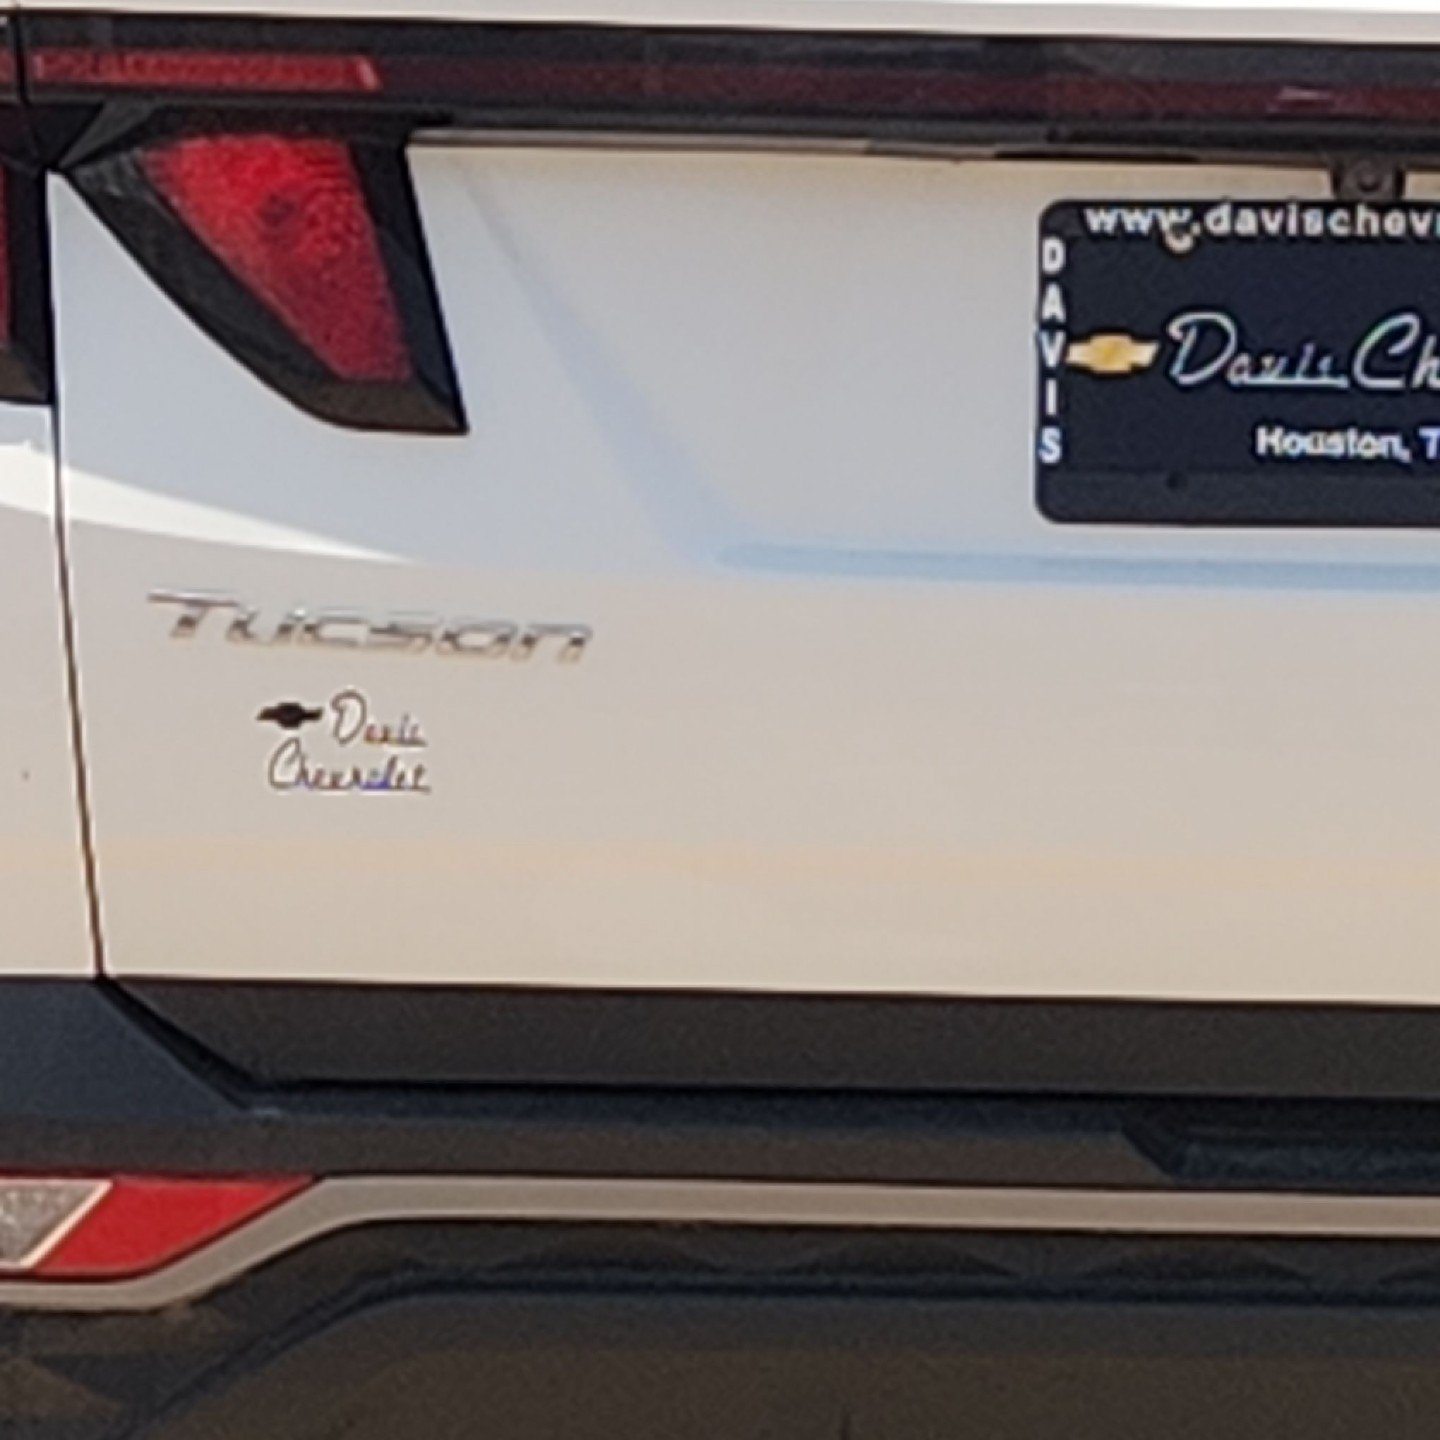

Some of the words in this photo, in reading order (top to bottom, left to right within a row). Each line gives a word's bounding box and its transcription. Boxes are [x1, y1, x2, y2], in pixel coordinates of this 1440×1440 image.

[1039, 236, 1067, 464] DAVIS
[1167, 311, 1349, 389] Davis
[1256, 425, 1411, 464] Houston,
